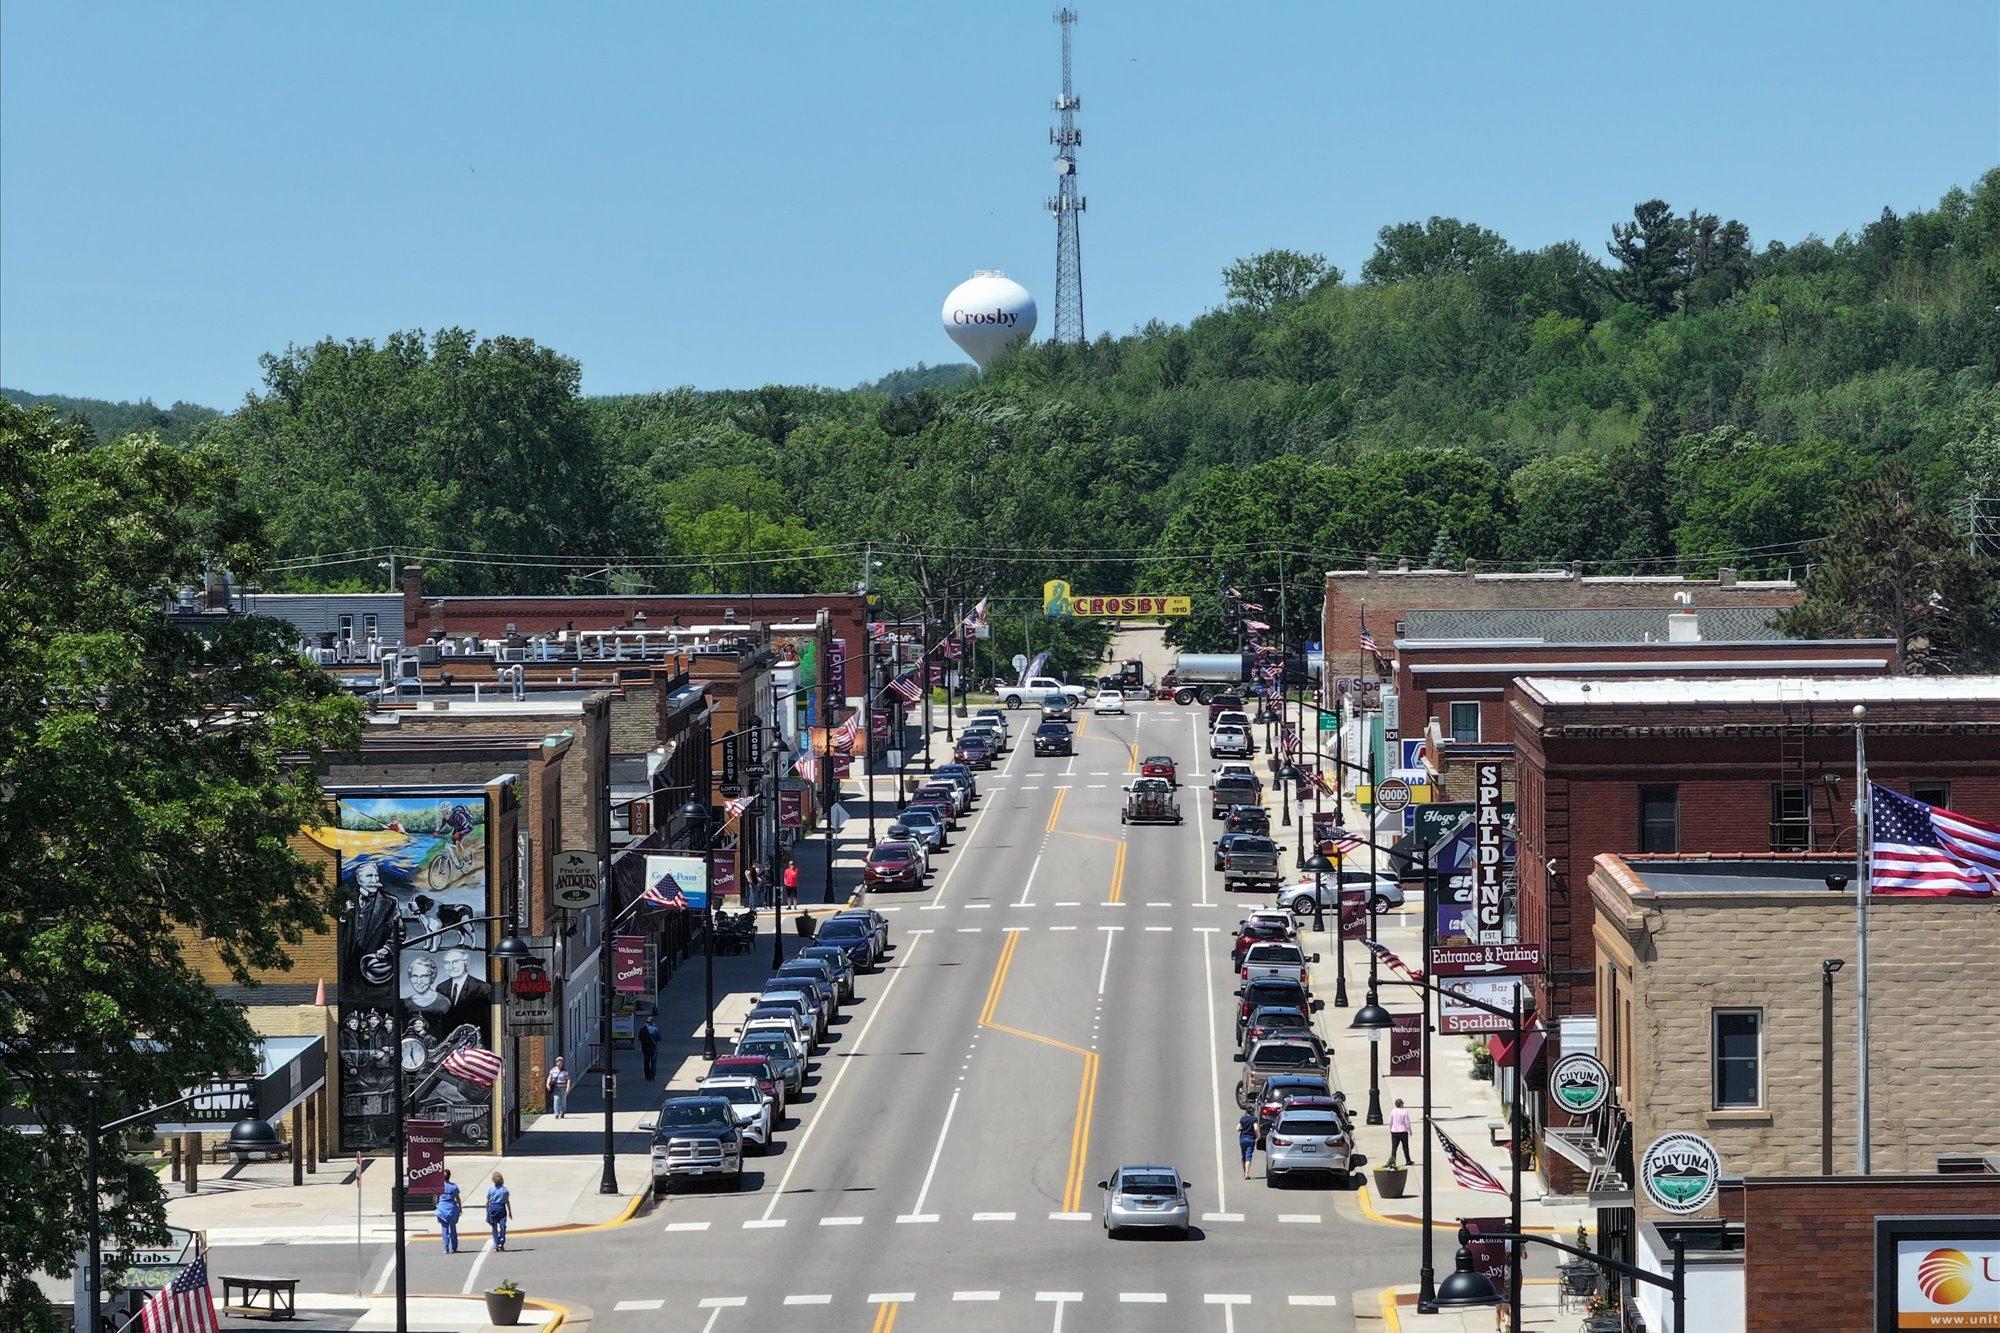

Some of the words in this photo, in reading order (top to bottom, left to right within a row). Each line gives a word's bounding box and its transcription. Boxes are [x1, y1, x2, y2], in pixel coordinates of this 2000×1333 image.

[953, 308, 1018, 328] Crosby
[1073, 598, 1168, 615] CROSBY
[1386, 731, 1398, 739] 101
[727, 741, 735, 781] CROSBY
[1379, 789, 1408, 800] GOODS
[635, 805, 643, 832] YOGA
[1424, 811, 1455, 826] Hoge
[1479, 766, 1500, 925] SPALDING
[518, 835, 526, 924] ANTIQUES
[555, 874, 597, 890] ANTIQUES
[713, 874, 735, 885] Crosby
[1343, 917, 1366, 931] Crosby
[1433, 949, 1482, 964] Entrance
[1485, 947, 1493, 962] &
[1495, 946, 1539, 963] Parking
[618, 966, 643, 981] Crosby
[1391, 1048, 1420, 1064] Crosby
[1559, 1071, 1599, 1082] CUYUNA
[409, 1135, 443, 1143] Welcome
[1652, 1153, 1709, 1170] CUYUNA
[409, 1161, 443, 1180] Crosby
[1481, 1253, 1490, 1261] to
[1485, 1264, 1503, 1279] sby
[1930, 1313, 1999, 1324] www.unit
